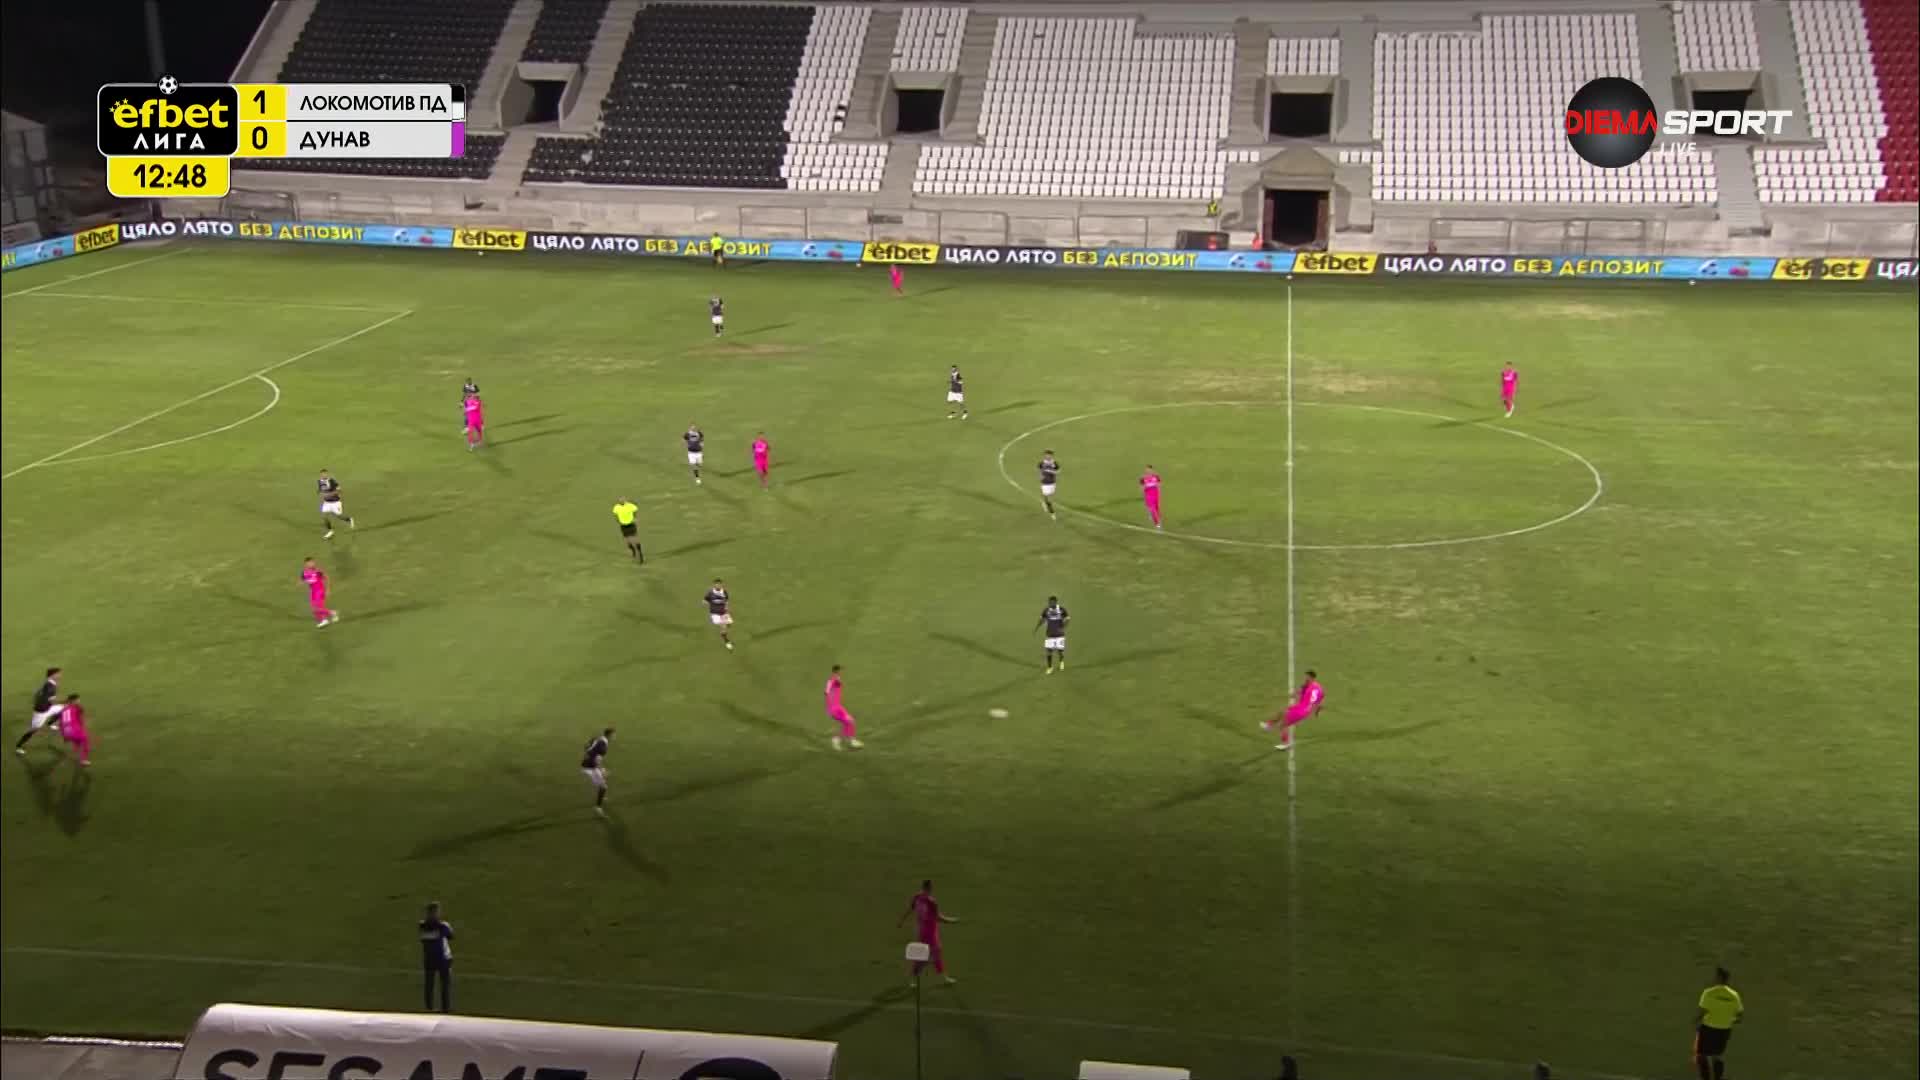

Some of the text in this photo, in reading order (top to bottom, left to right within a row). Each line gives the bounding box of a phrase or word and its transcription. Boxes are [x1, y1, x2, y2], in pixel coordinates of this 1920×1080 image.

[79, 229, 116, 250] efbet
[122, 221, 365, 240] ЦЯЛО ЛЯТО БЕЗ ДЕПОЗИТ
[461, 231, 521, 248] efbet
[533, 235, 772, 255] ЦЯЛО ЛЯТО БЕЗ ДЕОЗИТ
[871, 245, 932, 261] efbet
[945, 248, 1198, 267] ЦЯЛО ЛЯТО БЕЗ ДЕПОЗИТ
[1303, 255, 1369, 271] efbet
[1384, 257, 1665, 276] ЦЯЛО ЛЯТО БЕЗ ДЕПОЗИТ
